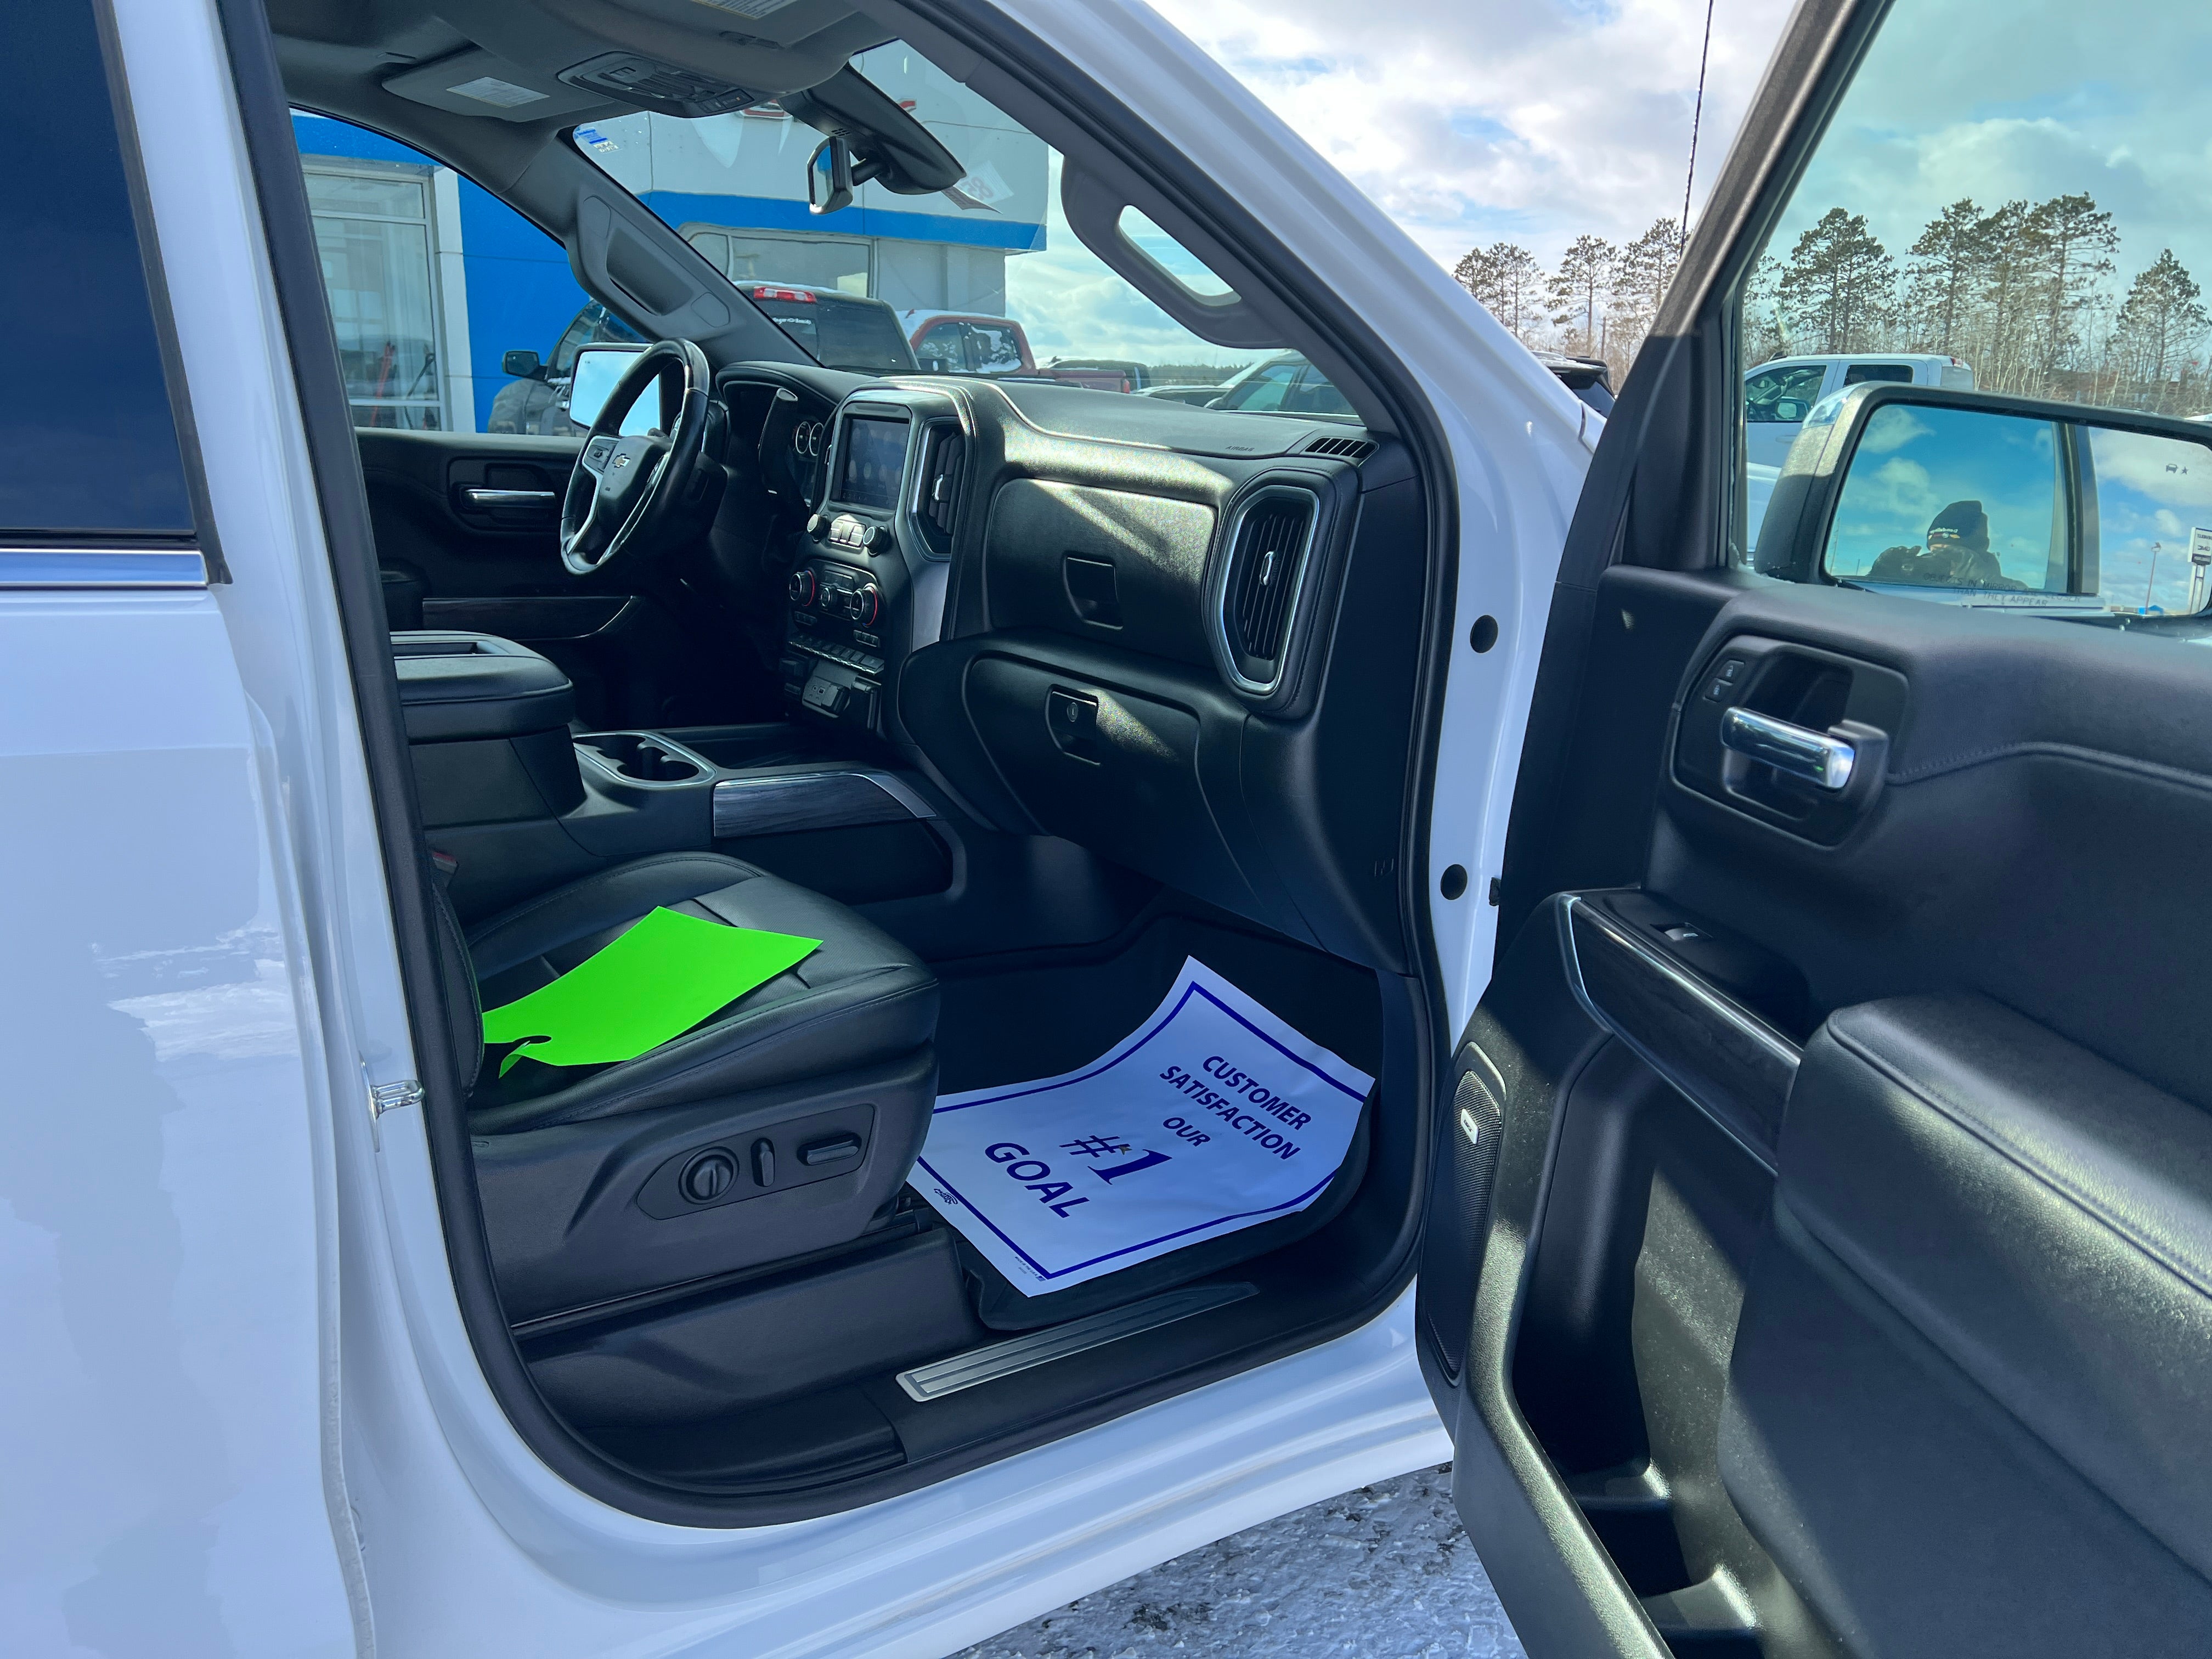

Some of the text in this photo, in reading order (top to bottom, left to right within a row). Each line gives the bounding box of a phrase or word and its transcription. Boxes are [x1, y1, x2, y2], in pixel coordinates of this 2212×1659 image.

[1967, 578, 1978, 589] IN
[1982, 581, 2018, 591] MIRROR
[1983, 592, 2006, 603] THEY
[2010, 595, 2049, 606] APPEAR
[1159, 1065, 1301, 1160] SATISFACTION
[1203, 1056, 1312, 1130] CUSTOMER
[1163, 1117, 1211, 1147] OUR
[985, 1142, 1090, 1218] GOAL
[1059, 1135, 1173, 1185] #1
